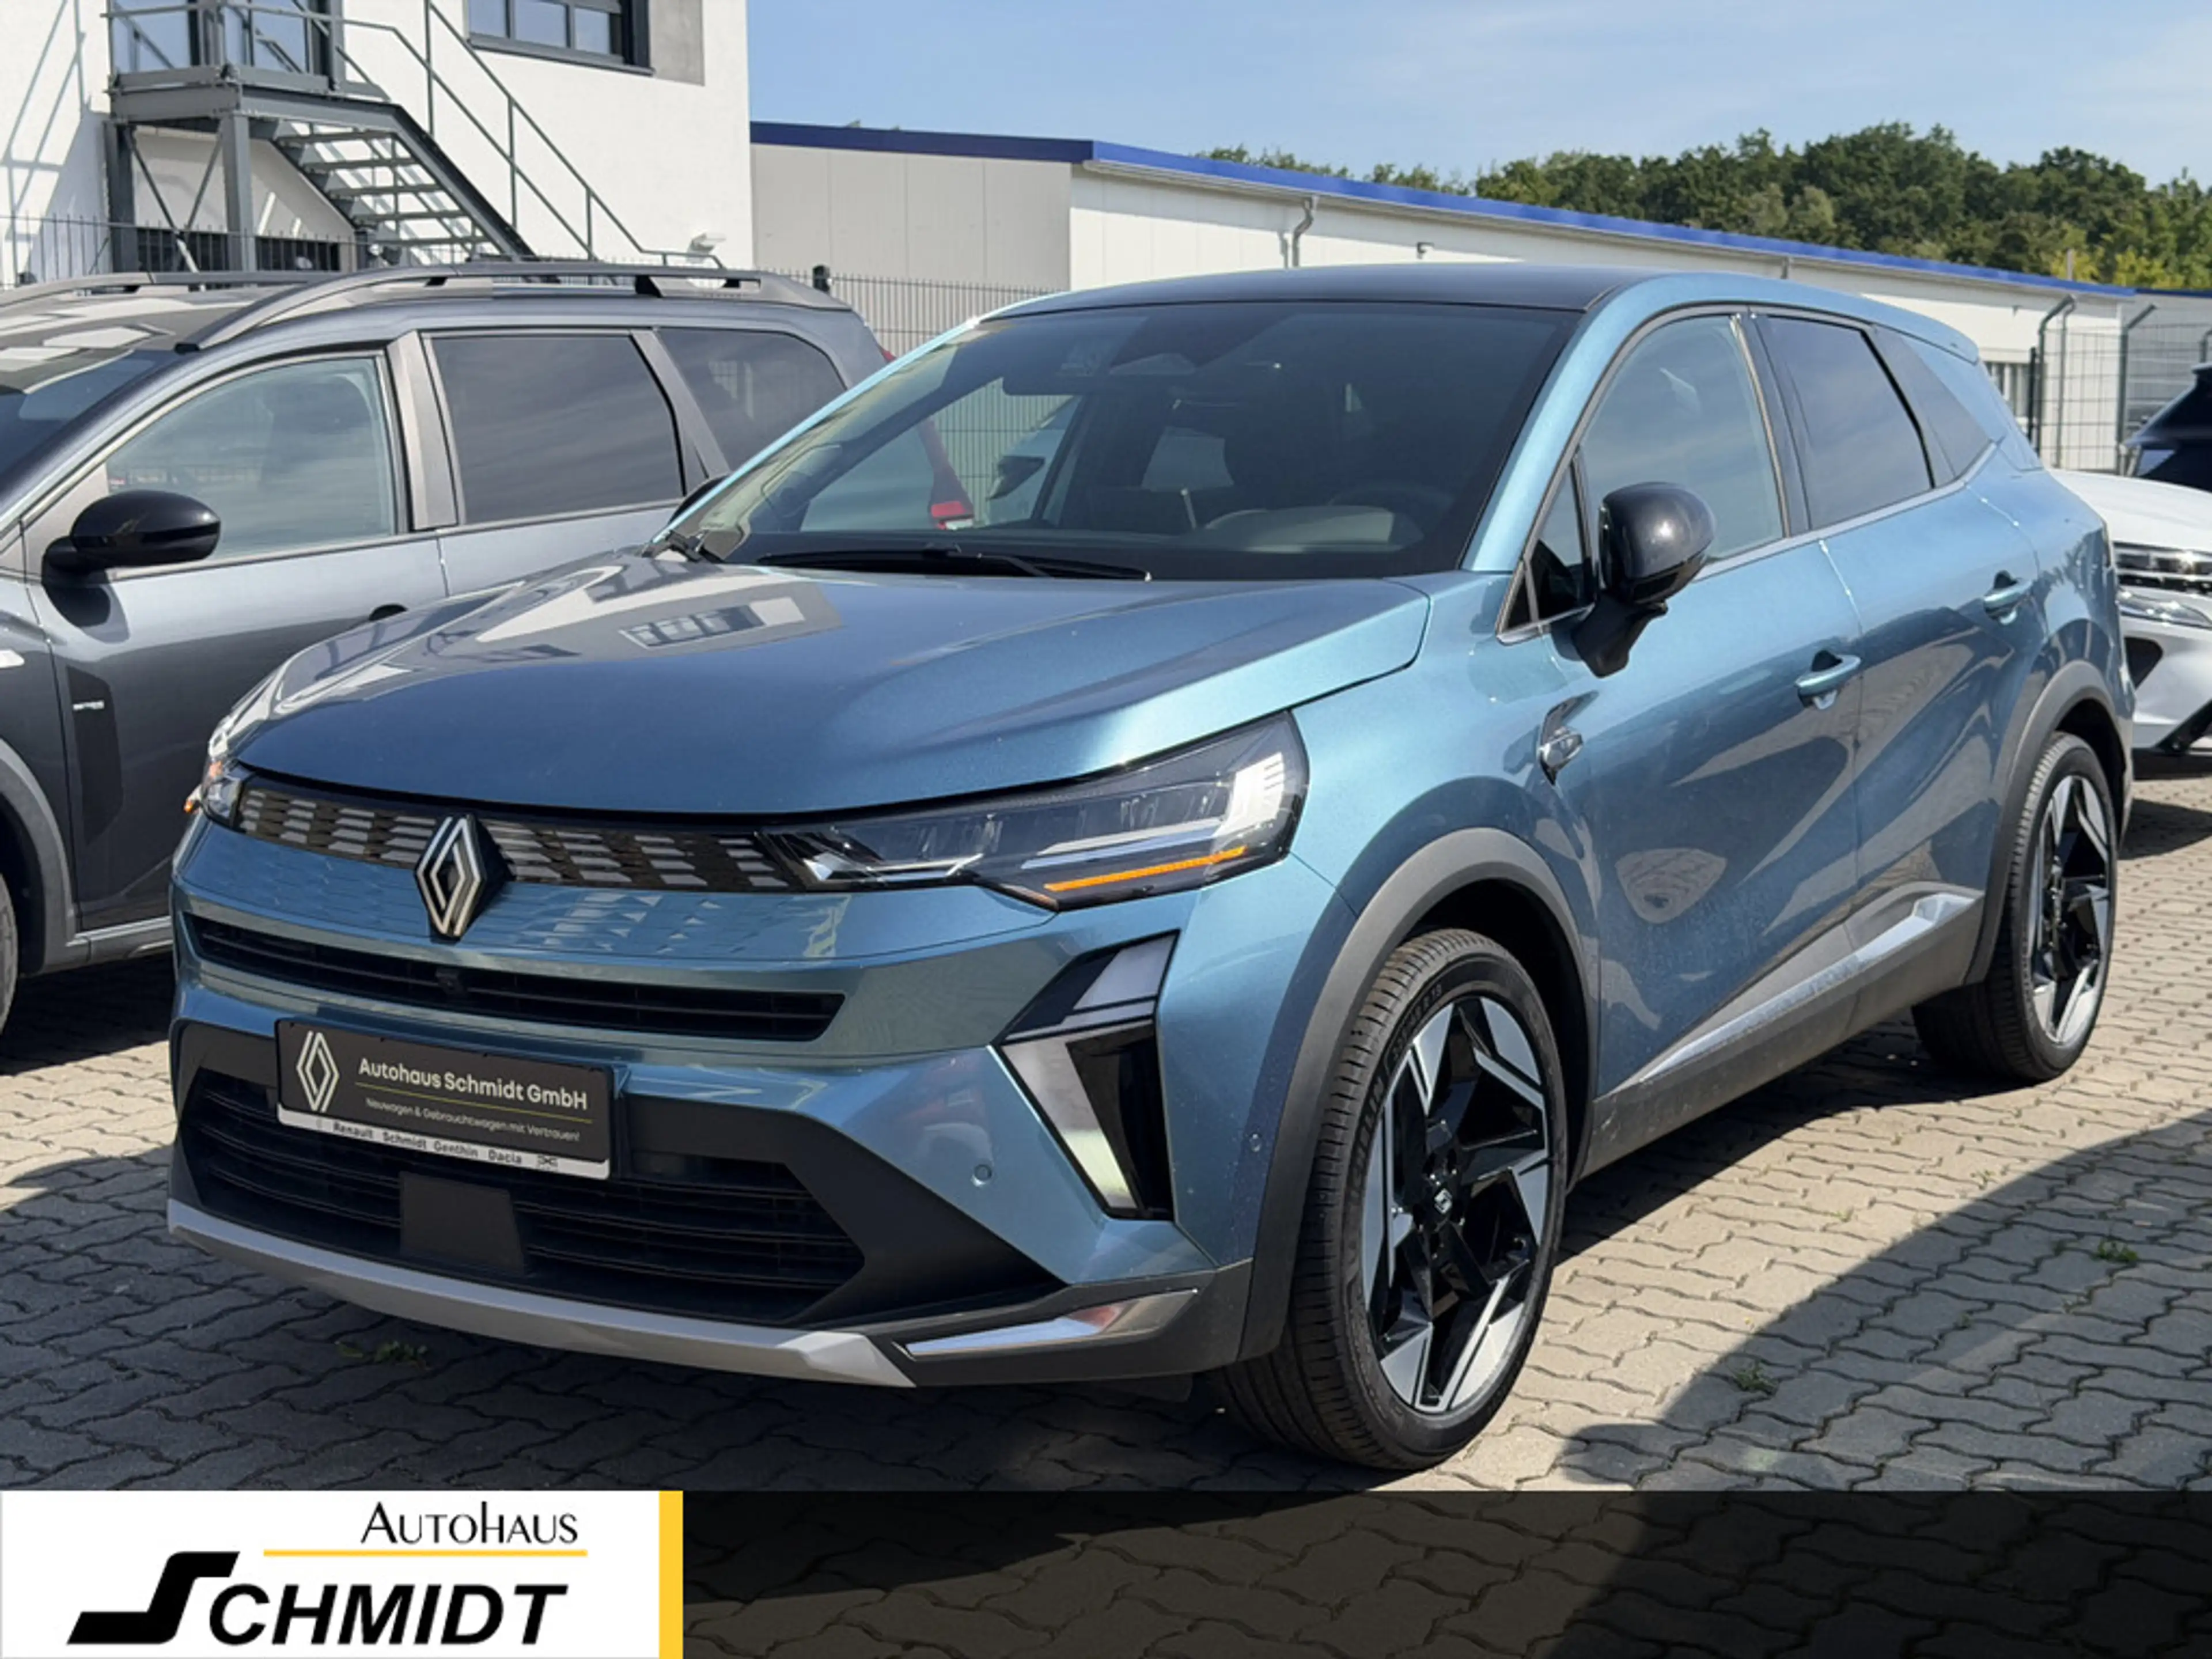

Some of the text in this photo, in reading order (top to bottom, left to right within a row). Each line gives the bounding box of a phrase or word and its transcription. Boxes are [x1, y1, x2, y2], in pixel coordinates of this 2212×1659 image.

[358, 1058, 588, 1111] Autohaus Schmidt GmbH
[365, 1097, 413, 1116] Neuwagen
[414, 1107, 422, 1118] &
[423, 1108, 506, 1131] Gebrauchtwagen
[332, 1122, 522, 1164] Renault Schmidt Genthin Dacia
